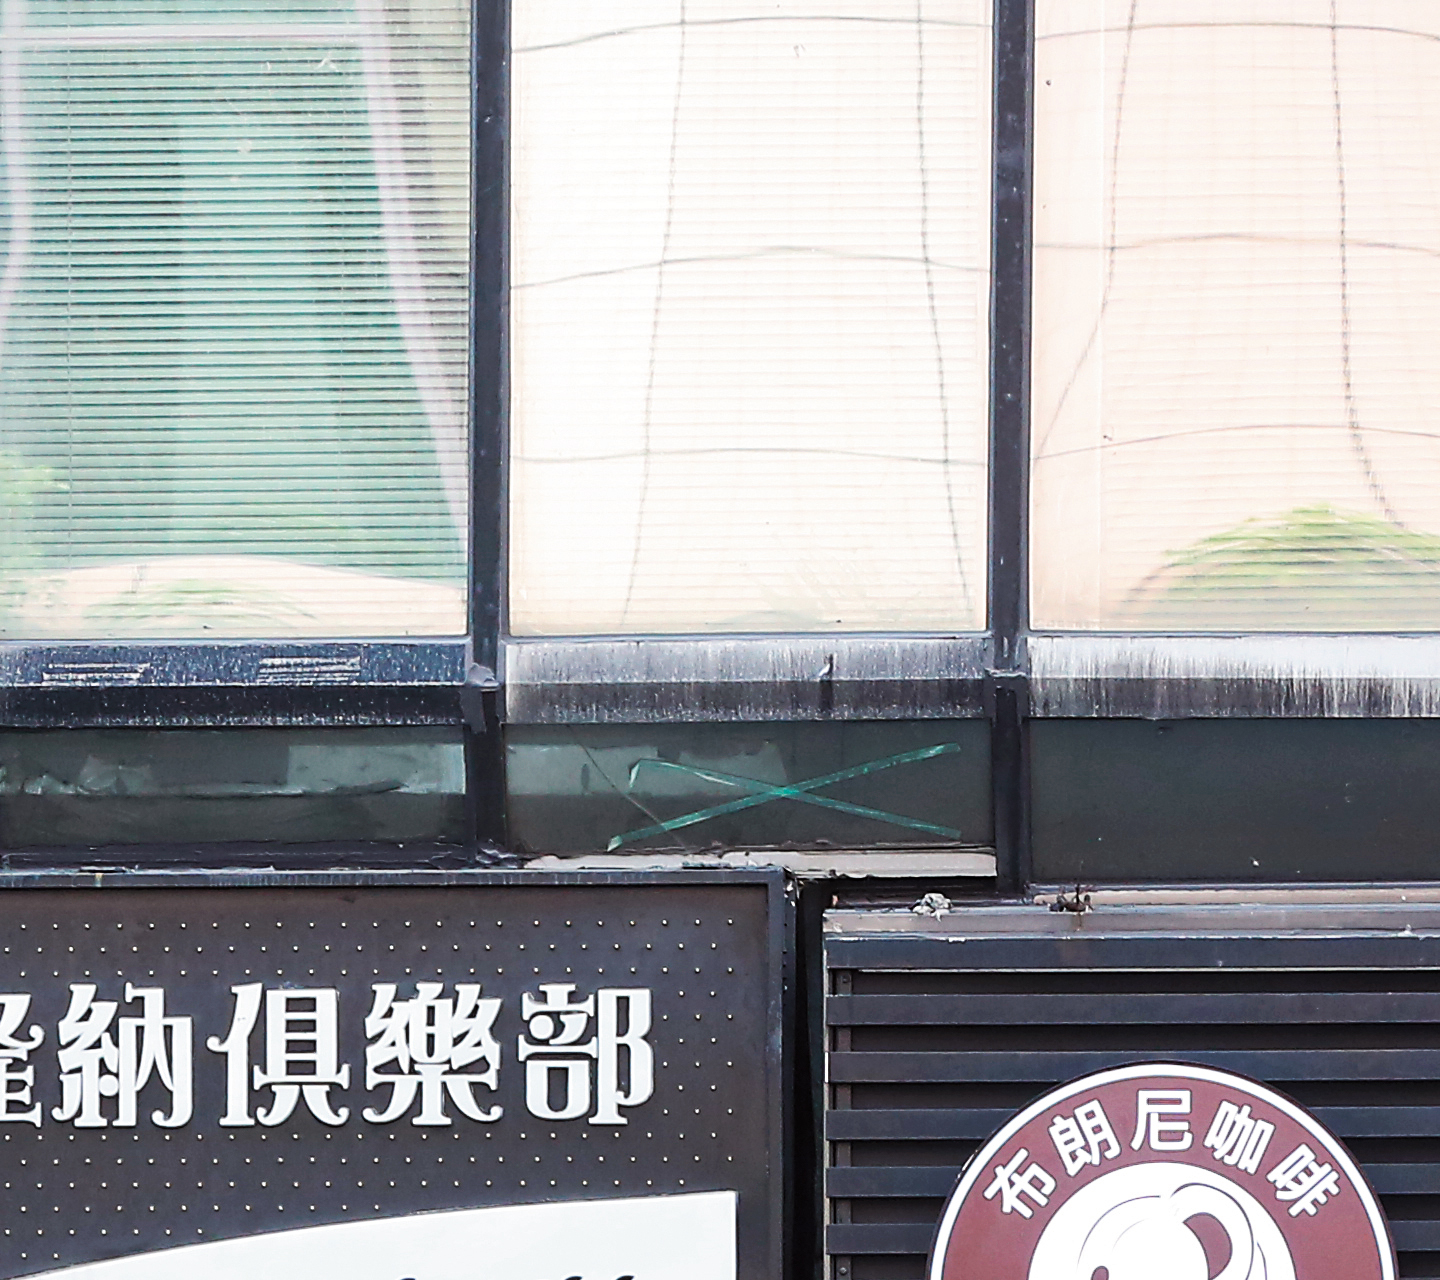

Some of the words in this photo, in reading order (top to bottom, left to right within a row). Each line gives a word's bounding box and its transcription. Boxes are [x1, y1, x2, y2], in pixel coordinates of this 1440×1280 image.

[984, 1089, 1340, 1219] 布朗尼咖啡
